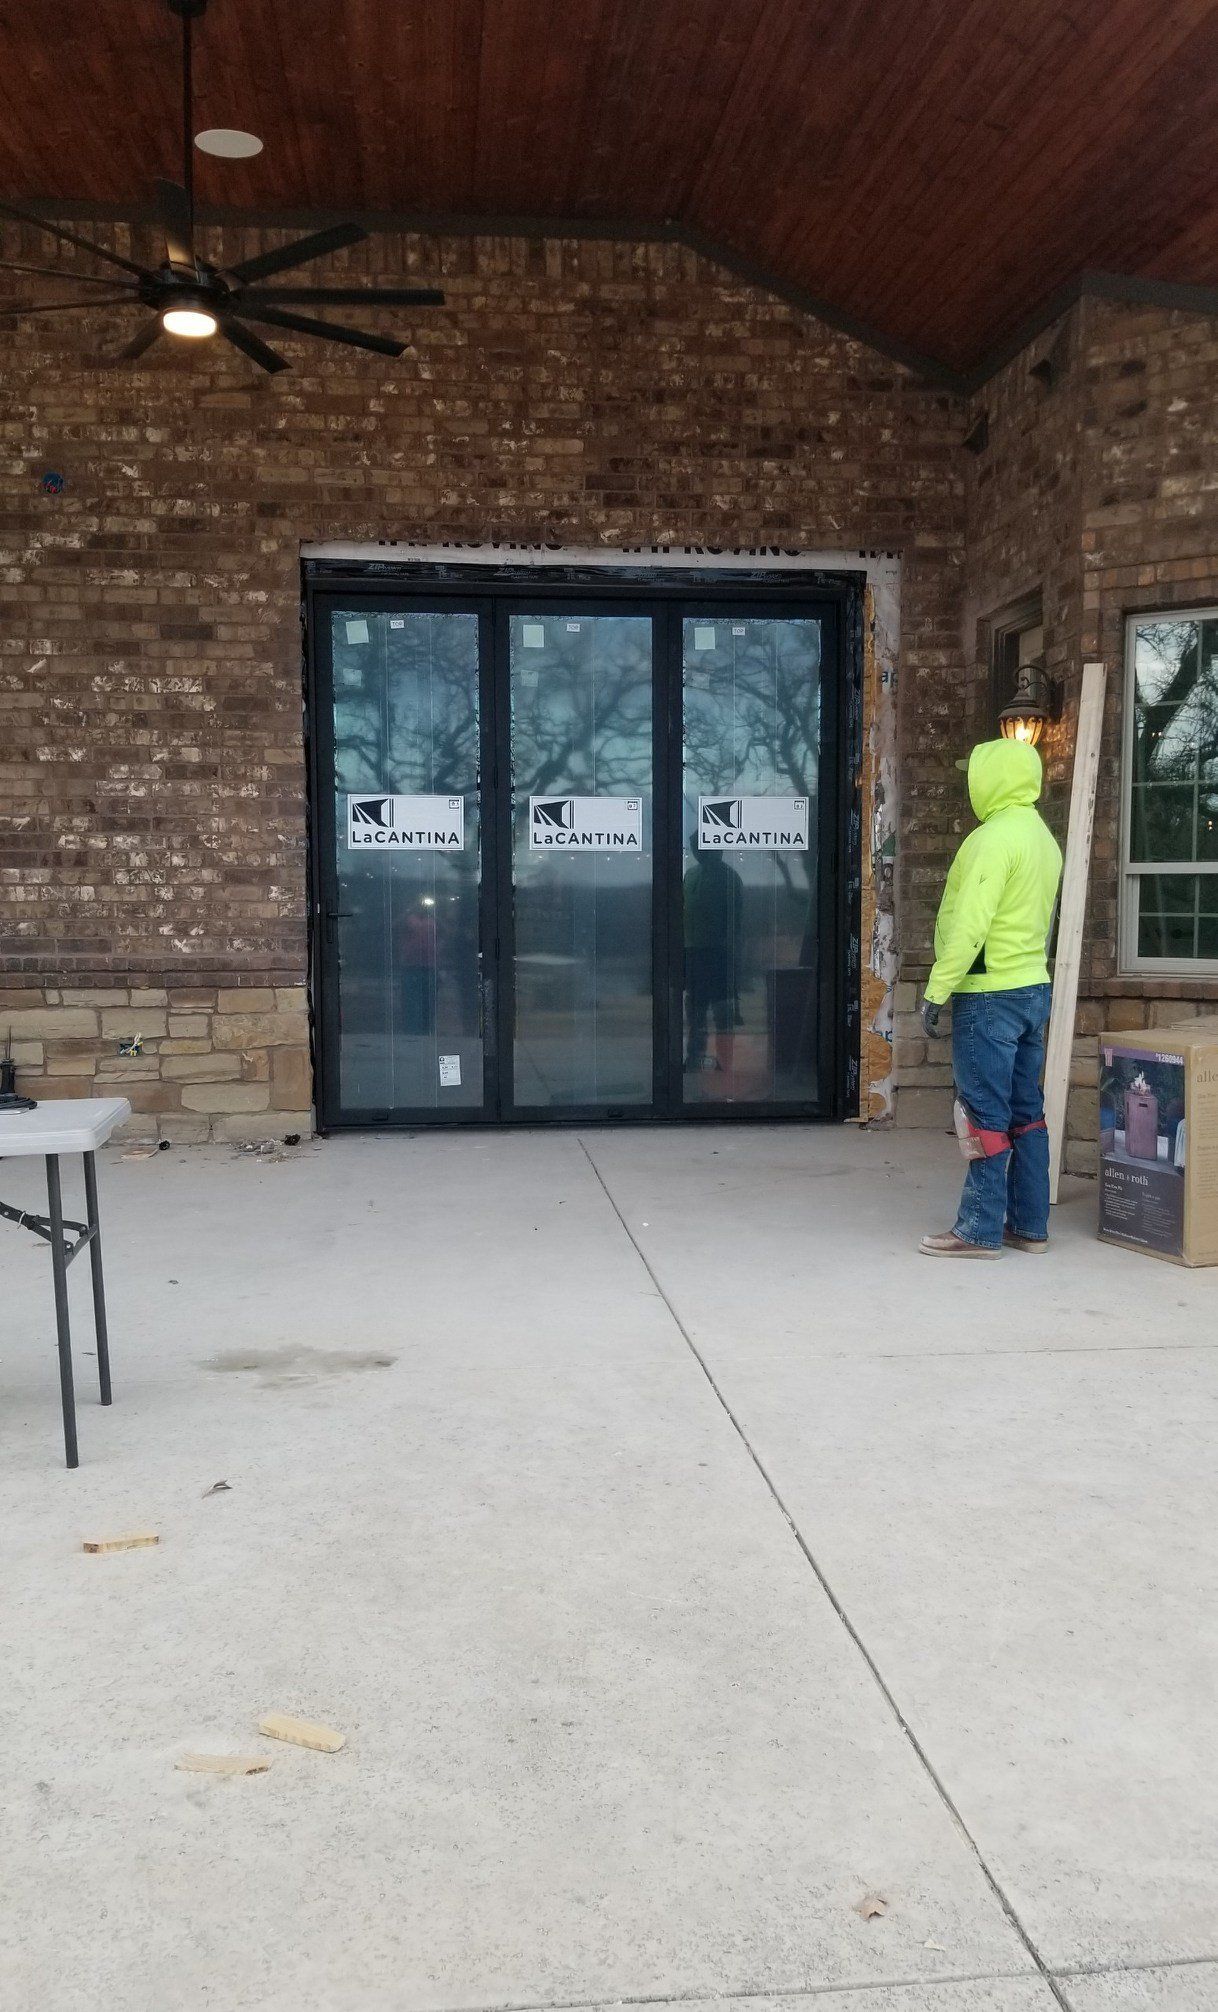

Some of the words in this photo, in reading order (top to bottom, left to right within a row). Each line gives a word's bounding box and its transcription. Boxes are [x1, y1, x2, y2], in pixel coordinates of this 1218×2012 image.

[352, 831, 460, 844] LaCANTINA
[533, 832, 638, 845] LaCANTINA
[702, 832, 804, 844] LaCANTINA
[1104, 1167, 1125, 1180] allen
[1131, 1175, 1149, 1186] roth
